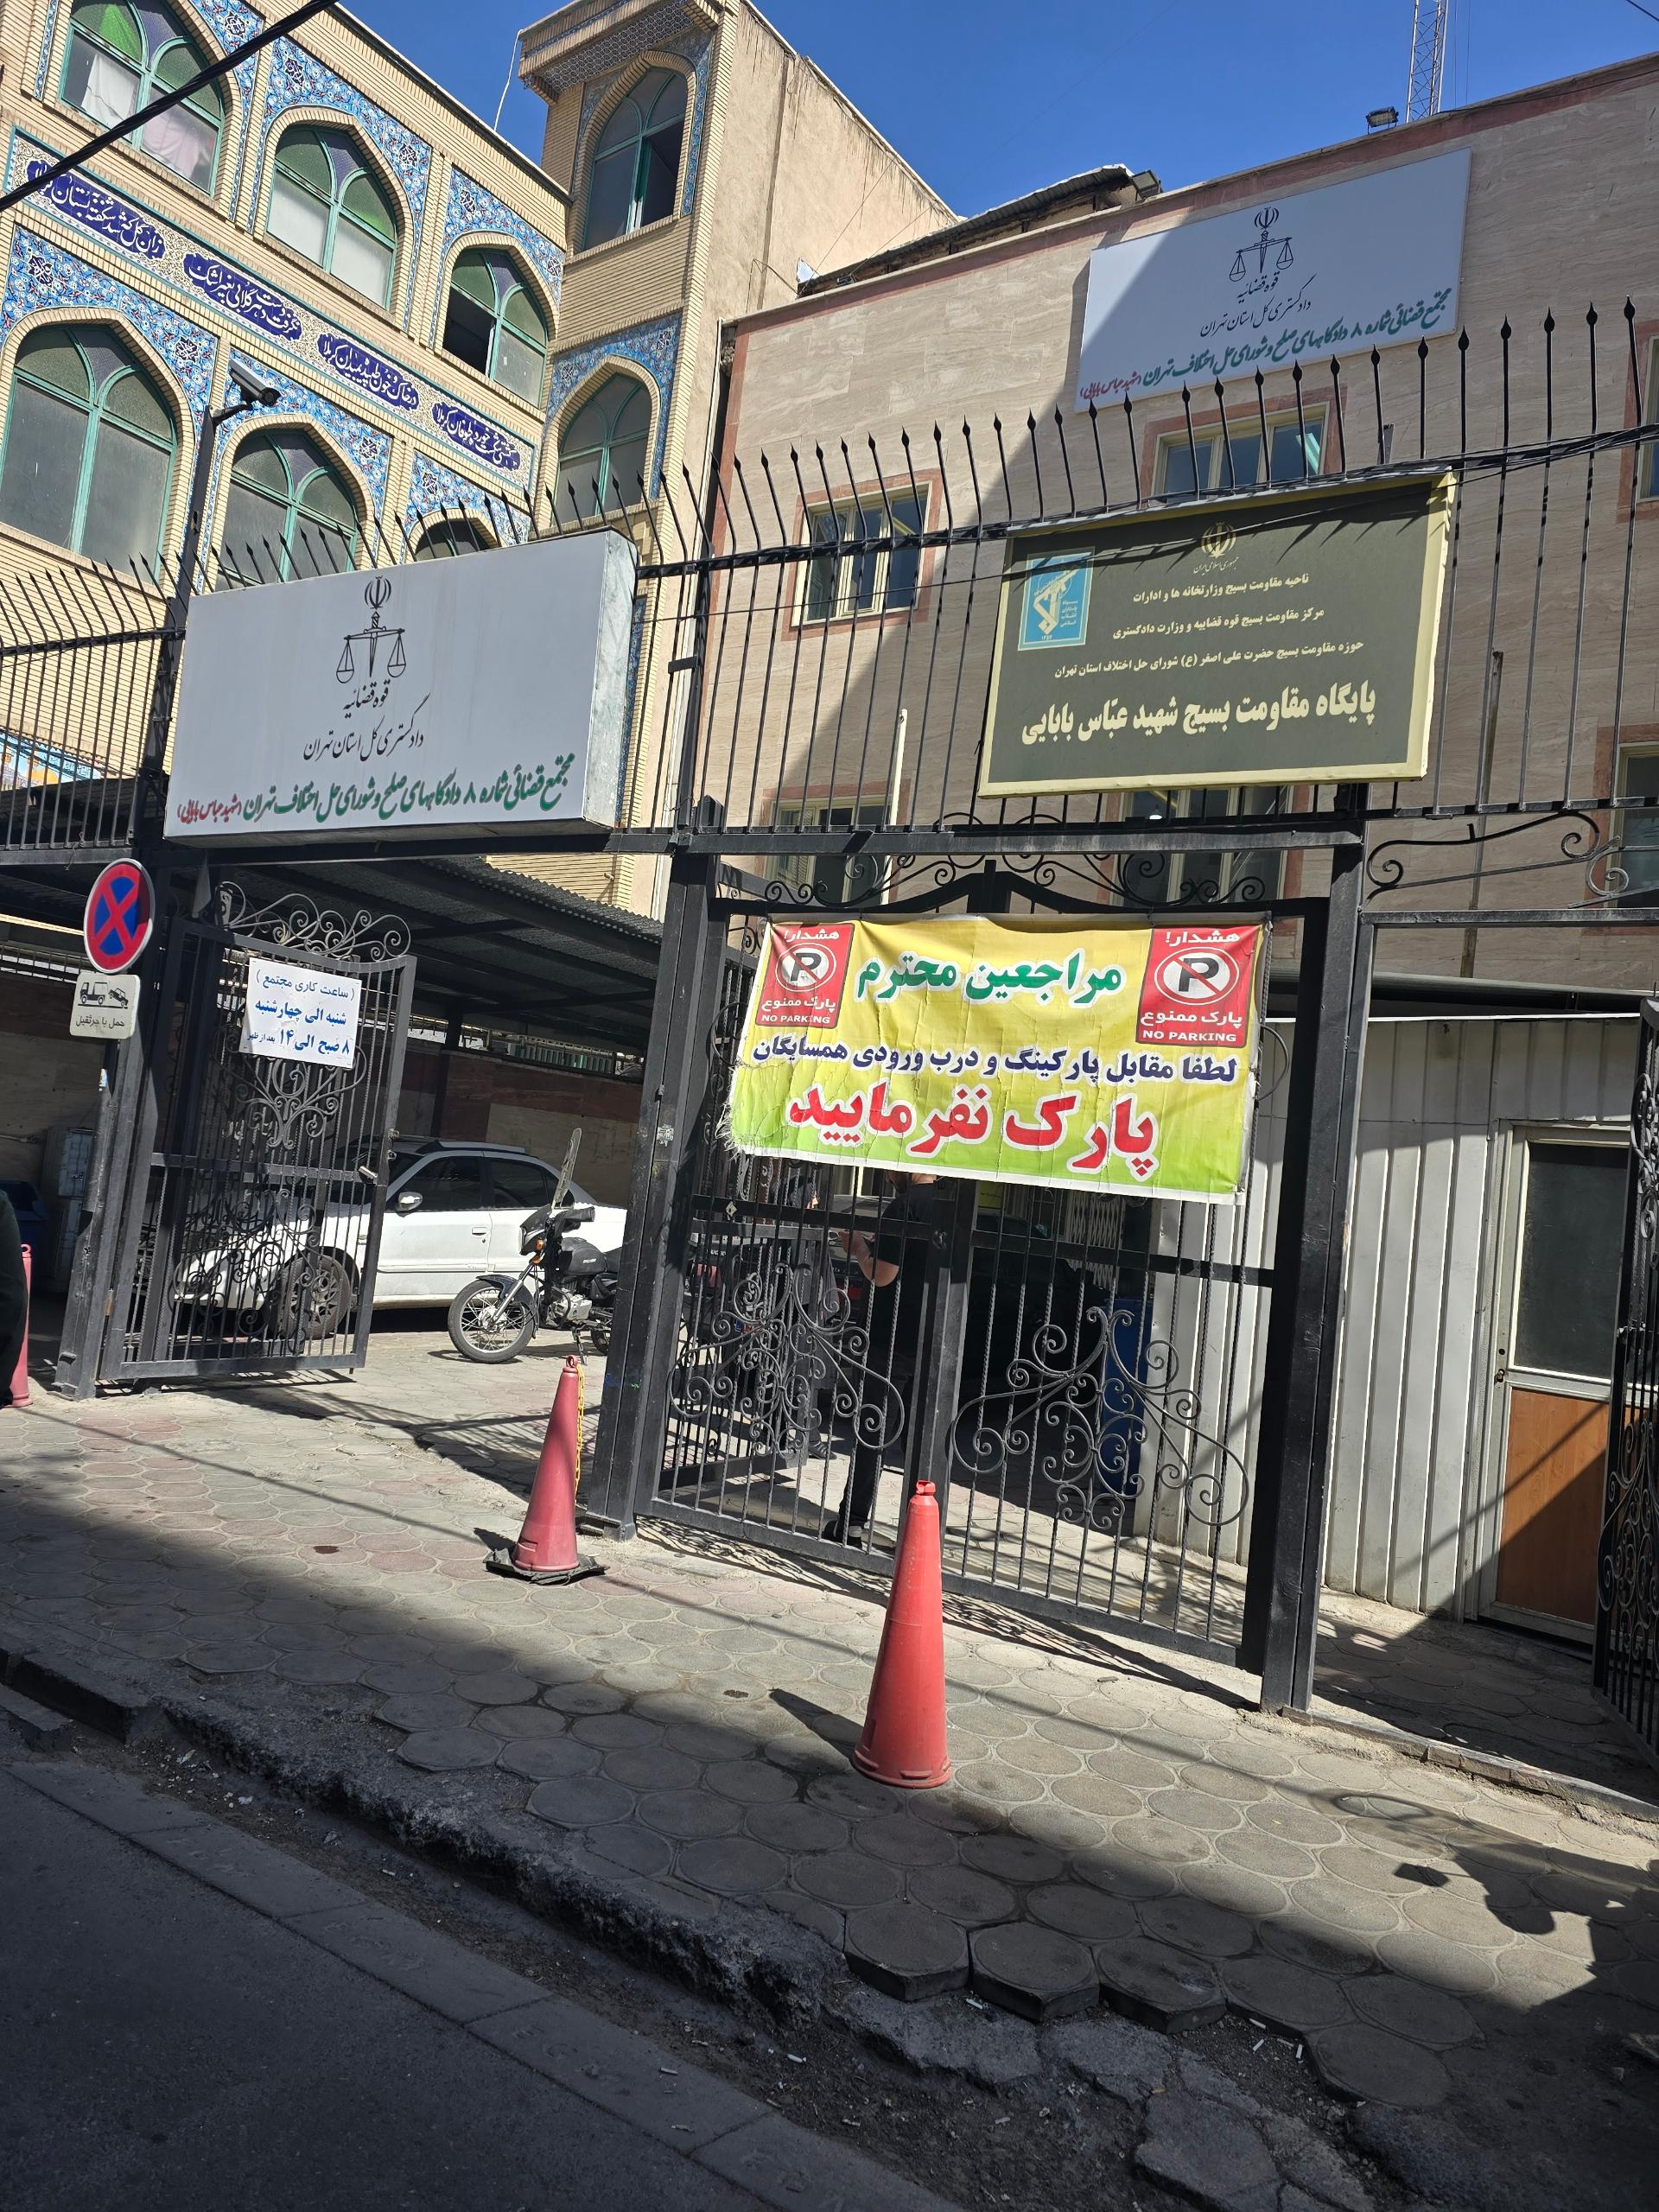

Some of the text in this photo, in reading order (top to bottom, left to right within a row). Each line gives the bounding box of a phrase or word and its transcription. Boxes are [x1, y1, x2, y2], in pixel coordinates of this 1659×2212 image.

[1263, 270, 1281, 292] قوه
[1199, 272, 1317, 337] دادگستری کل استان تهران
[1420, 287, 1452, 330] مجتمع
[1350, 321, 1363, 339] ۸
[1364, 308, 1392, 334] شماره
[1230, 334, 1268, 367] شورای
[1271, 328, 1298, 362] صلح
[1172, 348, 1216, 377] اختلاف
[1211, 346, 1234, 375] حل
[1142, 358, 1174, 386] تهران
[1225, 582, 1247, 595] بسیج
[1249, 576, 1282, 592] مقاومت
[1284, 573, 1310, 586] ناحیه
[1133, 590, 1161, 604] ادارات
[1163, 593, 1168, 601] و
[1224, 613, 1239, 629] قوه
[1241, 614, 1263, 627] بسیج
[1265, 608, 1300, 624] مقاومت
[1301, 607, 1325, 622] مرکز
[1112, 623, 1155, 639] دادگستری
[1157, 621, 1184, 635] وزارت
[1185, 623, 1192, 632] و
[1243, 648, 1274, 662] حضرت
[1276, 647, 1300, 660] بسیج
[1300, 642, 1336, 657] مقاومت
[1338, 641, 1364, 654] حوزه
[1103, 659, 1132, 672] اختلاف
[1133, 658, 1148, 671] حل
[1149, 655, 1179, 671] شورای
[1199, 652, 1222, 667] اصغر
[1223, 650, 1242, 664] علی
[1054, 665, 1077, 678] تهران
[1078, 662, 1102, 677] استان
[372, 678, 391, 708] قوه
[1236, 686, 1309, 731] مقاومت
[1315, 679, 1376, 726] پایگاه
[1021, 702, 1074, 745] بابایی
[1133, 696, 1179, 736] شهید
[1182, 700, 1230, 734] بسیج
[303, 691, 431, 762] دادگستری کل استان تهران
[479, 769, 509, 804] شماره
[539, 753, 575, 811] مجتمع
[274, 780, 319, 814] اختلاف
[316, 781, 340, 823] حل
[335, 776, 376, 817] شورای
[372, 792, 381, 810] و
[378, 771, 408, 820] صلح
[462, 781, 477, 805] ۸
[243, 785, 277, 823] تهران
[784, 928, 840, 943] هشدار!
[1165, 930, 1241, 947] هشدار!
[262, 975, 293, 988] مجتمع
[295, 981, 318, 993] کاری
[857, 952, 1122, 1004] مراجعین محترم
[320, 985, 348, 998] ساعت
[255, 1000, 346, 1027] شنبه الی چهارشنبه
[761, 996, 836, 1014] پارک ممنوع
[75, 1014, 124, 1029] حمل با جرثقیل
[780, 1015, 830, 1024] PARKING
[1141, 1011, 1243, 1029] پارک ممنوع
[258, 1033, 266, 1043] از
[280, 1028, 294, 1046] ۱۴
[294, 1033, 315, 1051] الی
[1142, 1030, 1236, 1042] NO PARKING
[318, 1037, 340, 1055] صبح
[341, 1039, 350, 1055] ۸
[753, 1034, 1238, 1084] لطفا مقابل پارکینگ و درب ورودی همسایگان
[789, 1082, 1154, 1177] پارک نفرمایید
